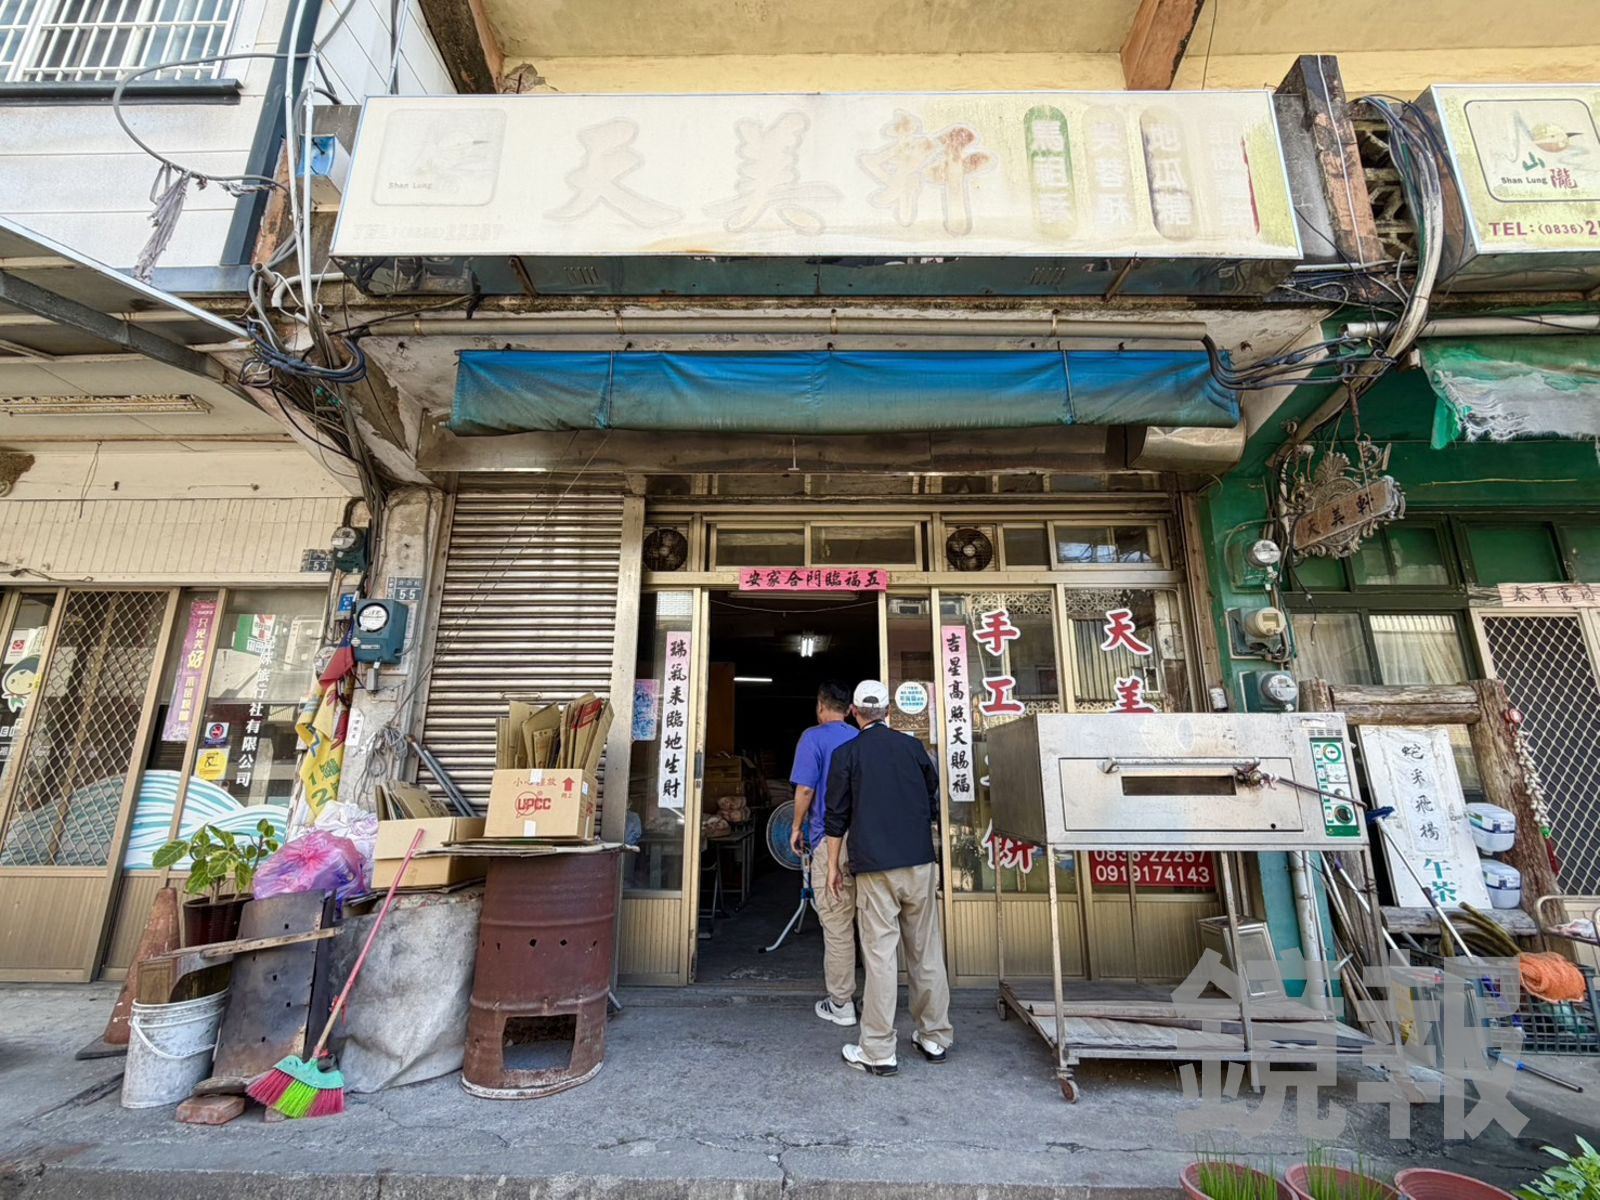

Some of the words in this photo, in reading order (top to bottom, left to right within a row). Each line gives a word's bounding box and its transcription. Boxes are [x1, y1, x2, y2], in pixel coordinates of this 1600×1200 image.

[1149, 121, 1193, 226] 地瓜糖
[1501, 176, 1523, 184] Shan
[1526, 176, 1548, 185] Lung
[1488, 220, 1600, 236] TEL:(0836)2
[312, 560, 328, 571] 53
[399, 588, 416, 599] 55
[1401, 743, 1439, 841] 蛇采飛揚
[517, 797, 552, 810] UPCC
[1096, 865, 1209, 882] 0919174143
